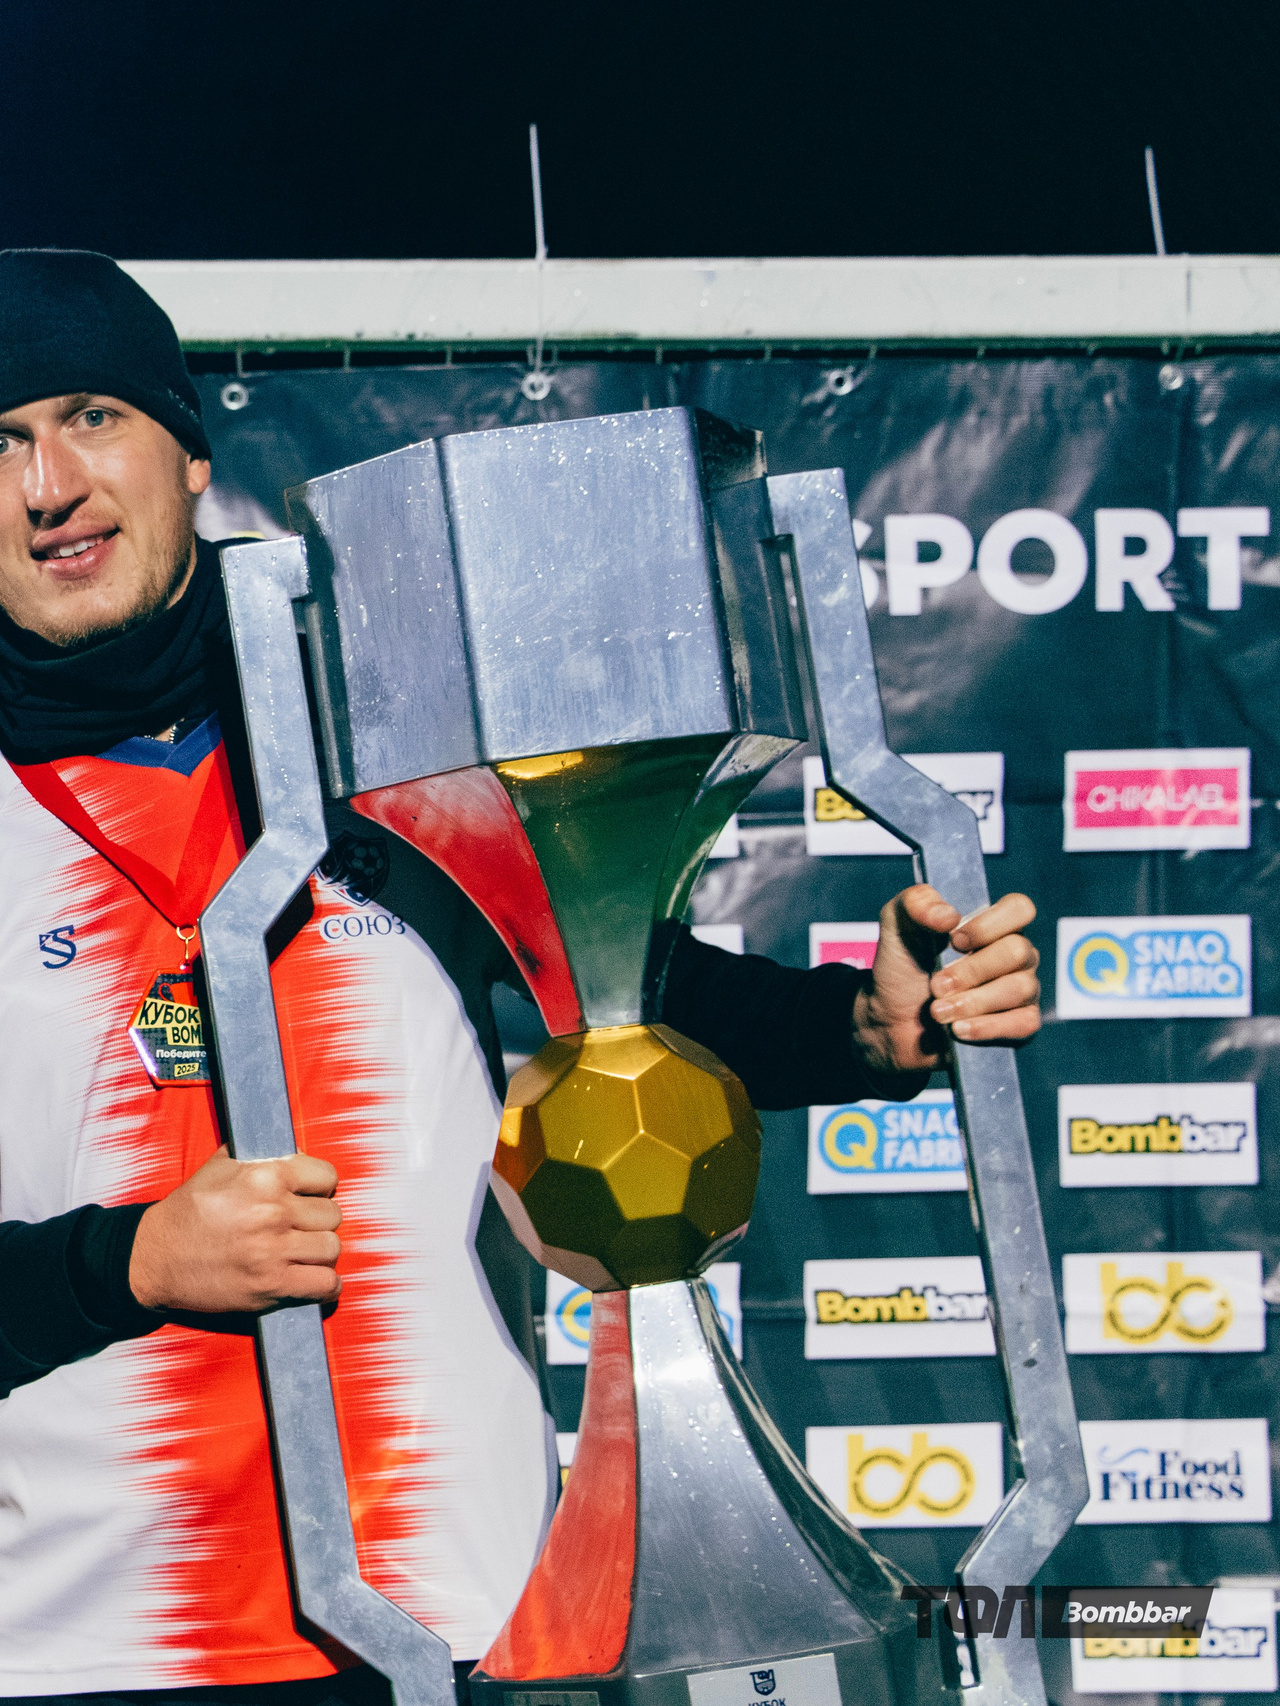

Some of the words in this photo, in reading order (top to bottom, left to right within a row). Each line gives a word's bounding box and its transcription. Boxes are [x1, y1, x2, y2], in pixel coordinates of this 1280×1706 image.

[323, 914, 406, 940] СОЮЗ
[1133, 934, 1224, 965] SNAQ
[1135, 964, 1238, 995] FABRIQ
[138, 1001, 201, 1026] КУБОК
[155, 1049, 207, 1059] Победите
[176, 1064, 196, 1075] 2025
[1069, 1116, 1246, 1155] Bombbar
[815, 1286, 988, 1324] Bombbar
[1159, 1451, 1241, 1476] Food
[1100, 1471, 1244, 1500] Fitness
